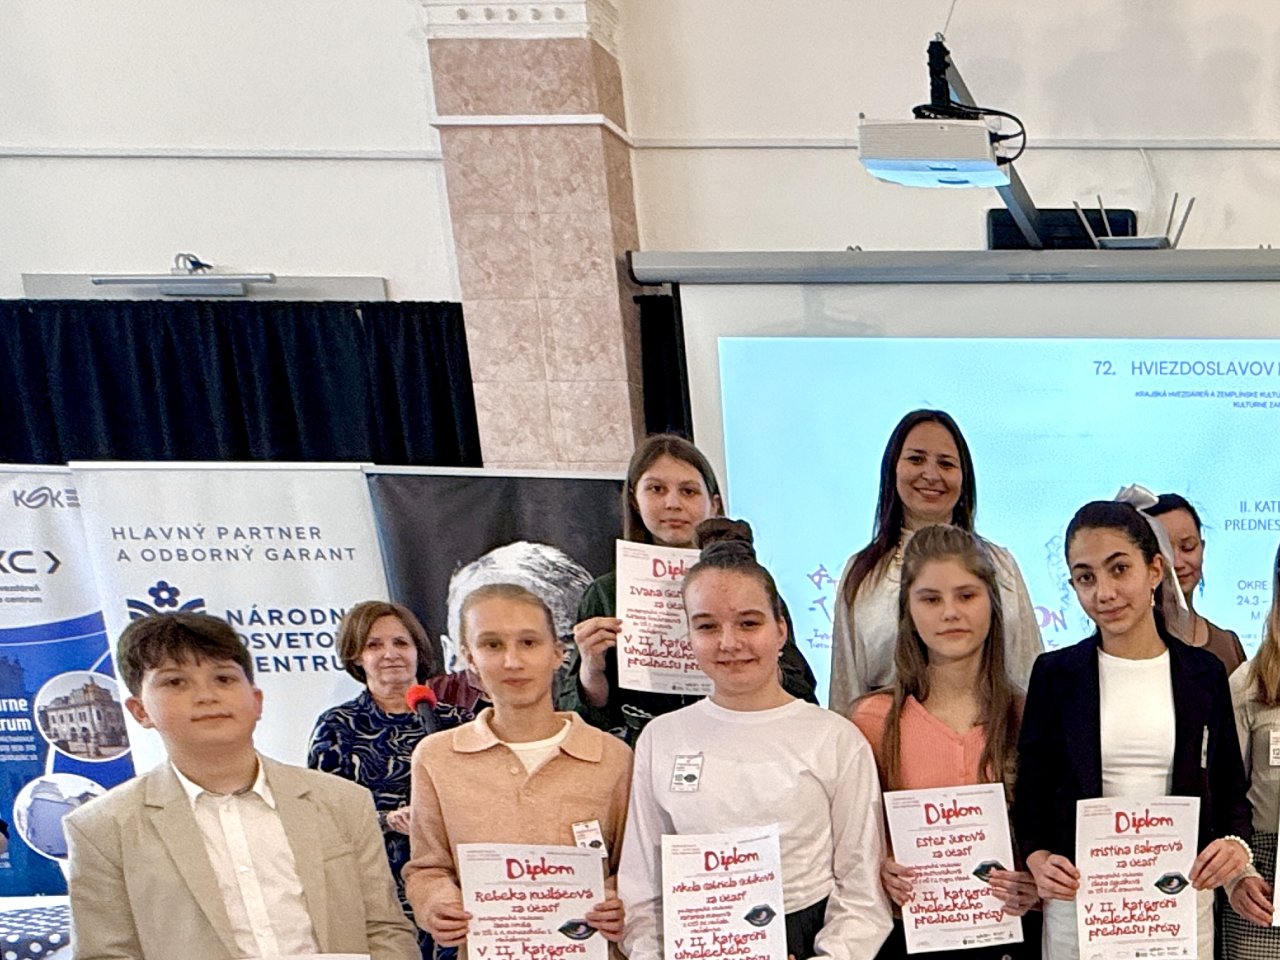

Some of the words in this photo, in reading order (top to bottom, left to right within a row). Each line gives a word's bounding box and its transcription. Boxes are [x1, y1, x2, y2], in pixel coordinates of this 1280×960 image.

[1093, 361, 1116, 376] 72.
[1131, 361, 1274, 376] HVIEZDOSLAVOV
[1240, 501, 1250, 512] II.
[111, 524, 205, 540] HLAVNÝ
[217, 526, 321, 540] PARTNER
[118, 549, 130, 562] A
[140, 545, 254, 562] ODBORNÝ
[265, 548, 355, 560] GARANT
[630, 586, 662, 597] Ivana
[1237, 580, 1268, 590] OKRE
[226, 604, 345, 626] NÁRODN
[256, 656, 345, 673] ENTRU
[628, 657, 681, 669] prednesu
[924, 799, 982, 825] Diplom
[1115, 809, 1173, 834] Diplom
[704, 847, 759, 871] Diplom
[506, 857, 575, 880] Diplom
[475, 888, 527, 902] Rebeka
[910, 901, 983, 915] umeleckého
[1123, 898, 1177, 911] kategórii
[915, 913, 969, 929] prednesu
[1085, 911, 1160, 926] umeleckého
[713, 932, 767, 946] kategórii
[1089, 925, 1145, 942] prednesu
[1149, 923, 1180, 937] prózy
[522, 942, 586, 956] kategórii
[675, 944, 751, 960] umeleckého
